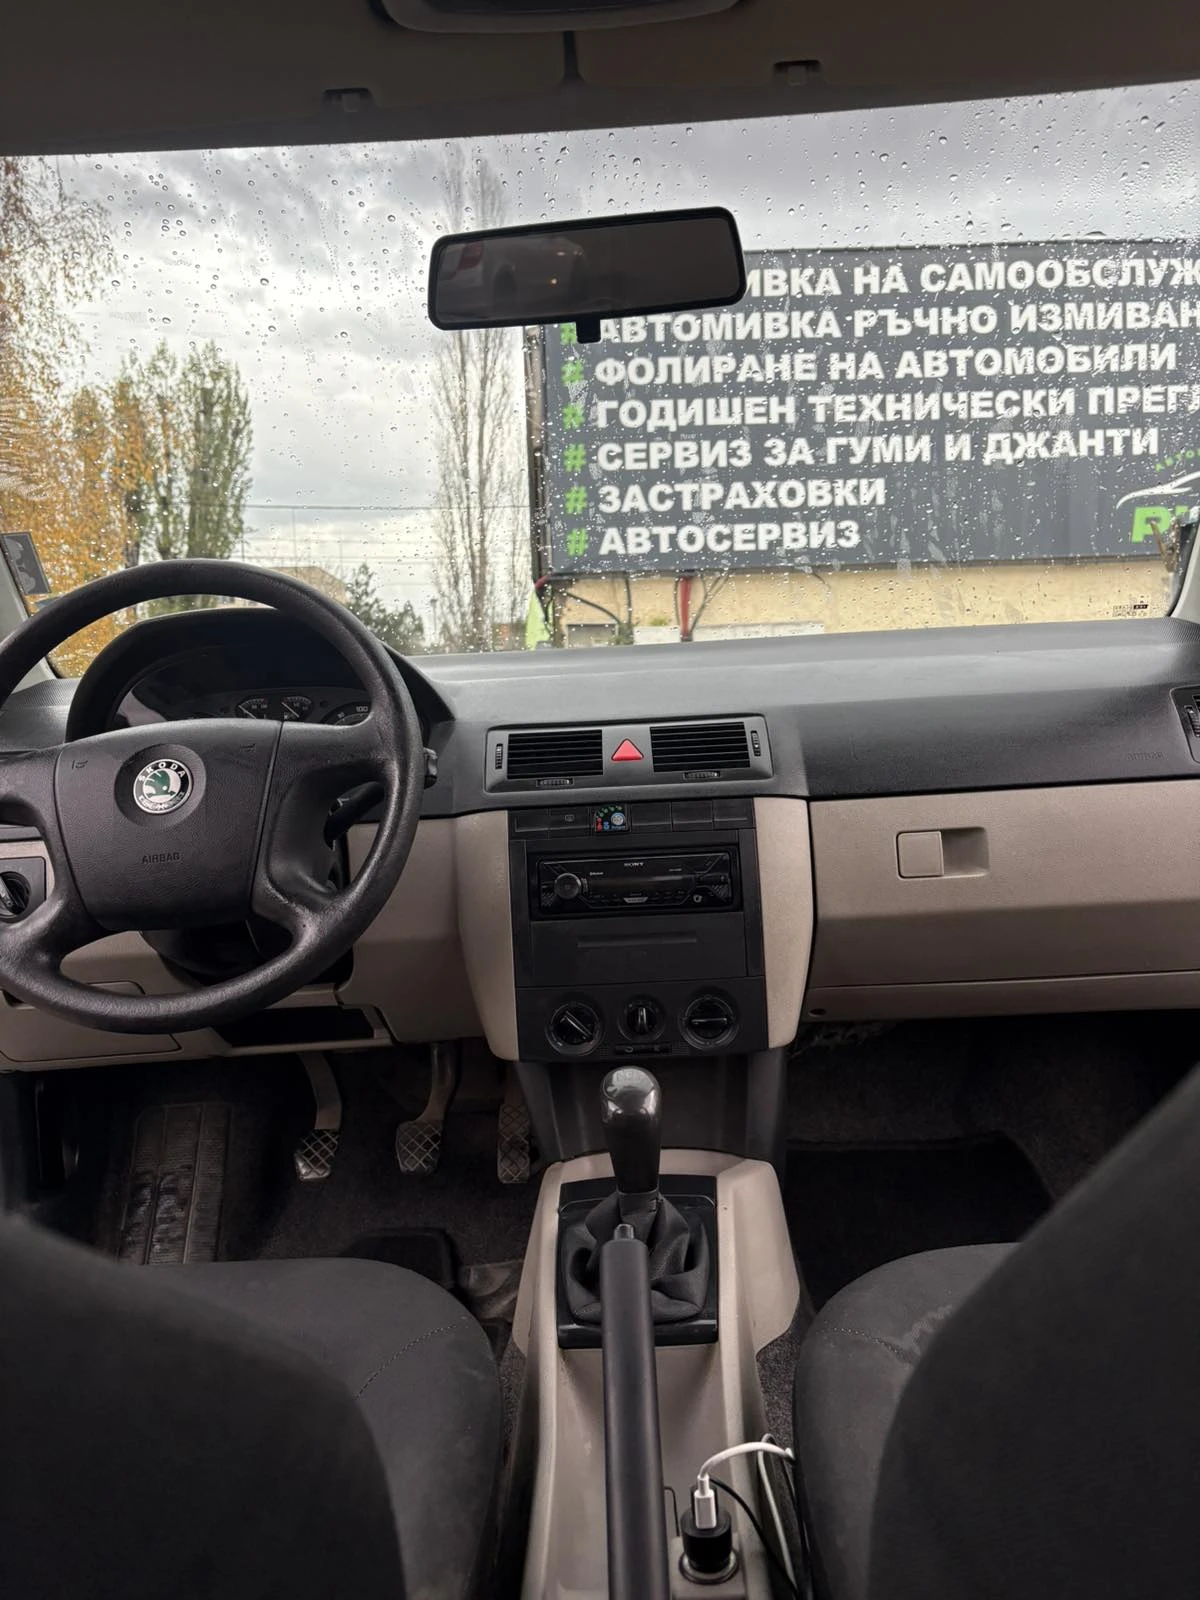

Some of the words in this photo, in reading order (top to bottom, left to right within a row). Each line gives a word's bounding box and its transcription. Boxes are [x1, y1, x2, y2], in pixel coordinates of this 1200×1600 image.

[853, 265, 909, 294] НА
[920, 258, 1200, 293] САМООБСЛУЖ
[600, 310, 843, 343] АВТОМИВКА
[853, 305, 998, 337] РЪЧНО
[1010, 300, 1200, 332] ИЗМИВАН
[595, 353, 818, 386] ФОЛИРАНЕ
[829, 350, 885, 380] НА
[895, 343, 1177, 379] АВТОМОБИЛИ
[597, 396, 796, 432] ГОДИШЕН
[808, 388, 1075, 423] ТЕХНИЧЕСКИ
[597, 438, 751, 471] СЕРВИЗ
[763, 437, 815, 467] ЗА
[827, 434, 931, 465] ГУМИ
[945, 433, 972, 462] И
[982, 428, 1159, 466] ДЖАНТИ
[599, 477, 886, 514] ЗАСТРАХОВКИ
[599, 519, 860, 556] АВТОСЕРВИЗ
[142, 852, 180, 864] AIRBAG
